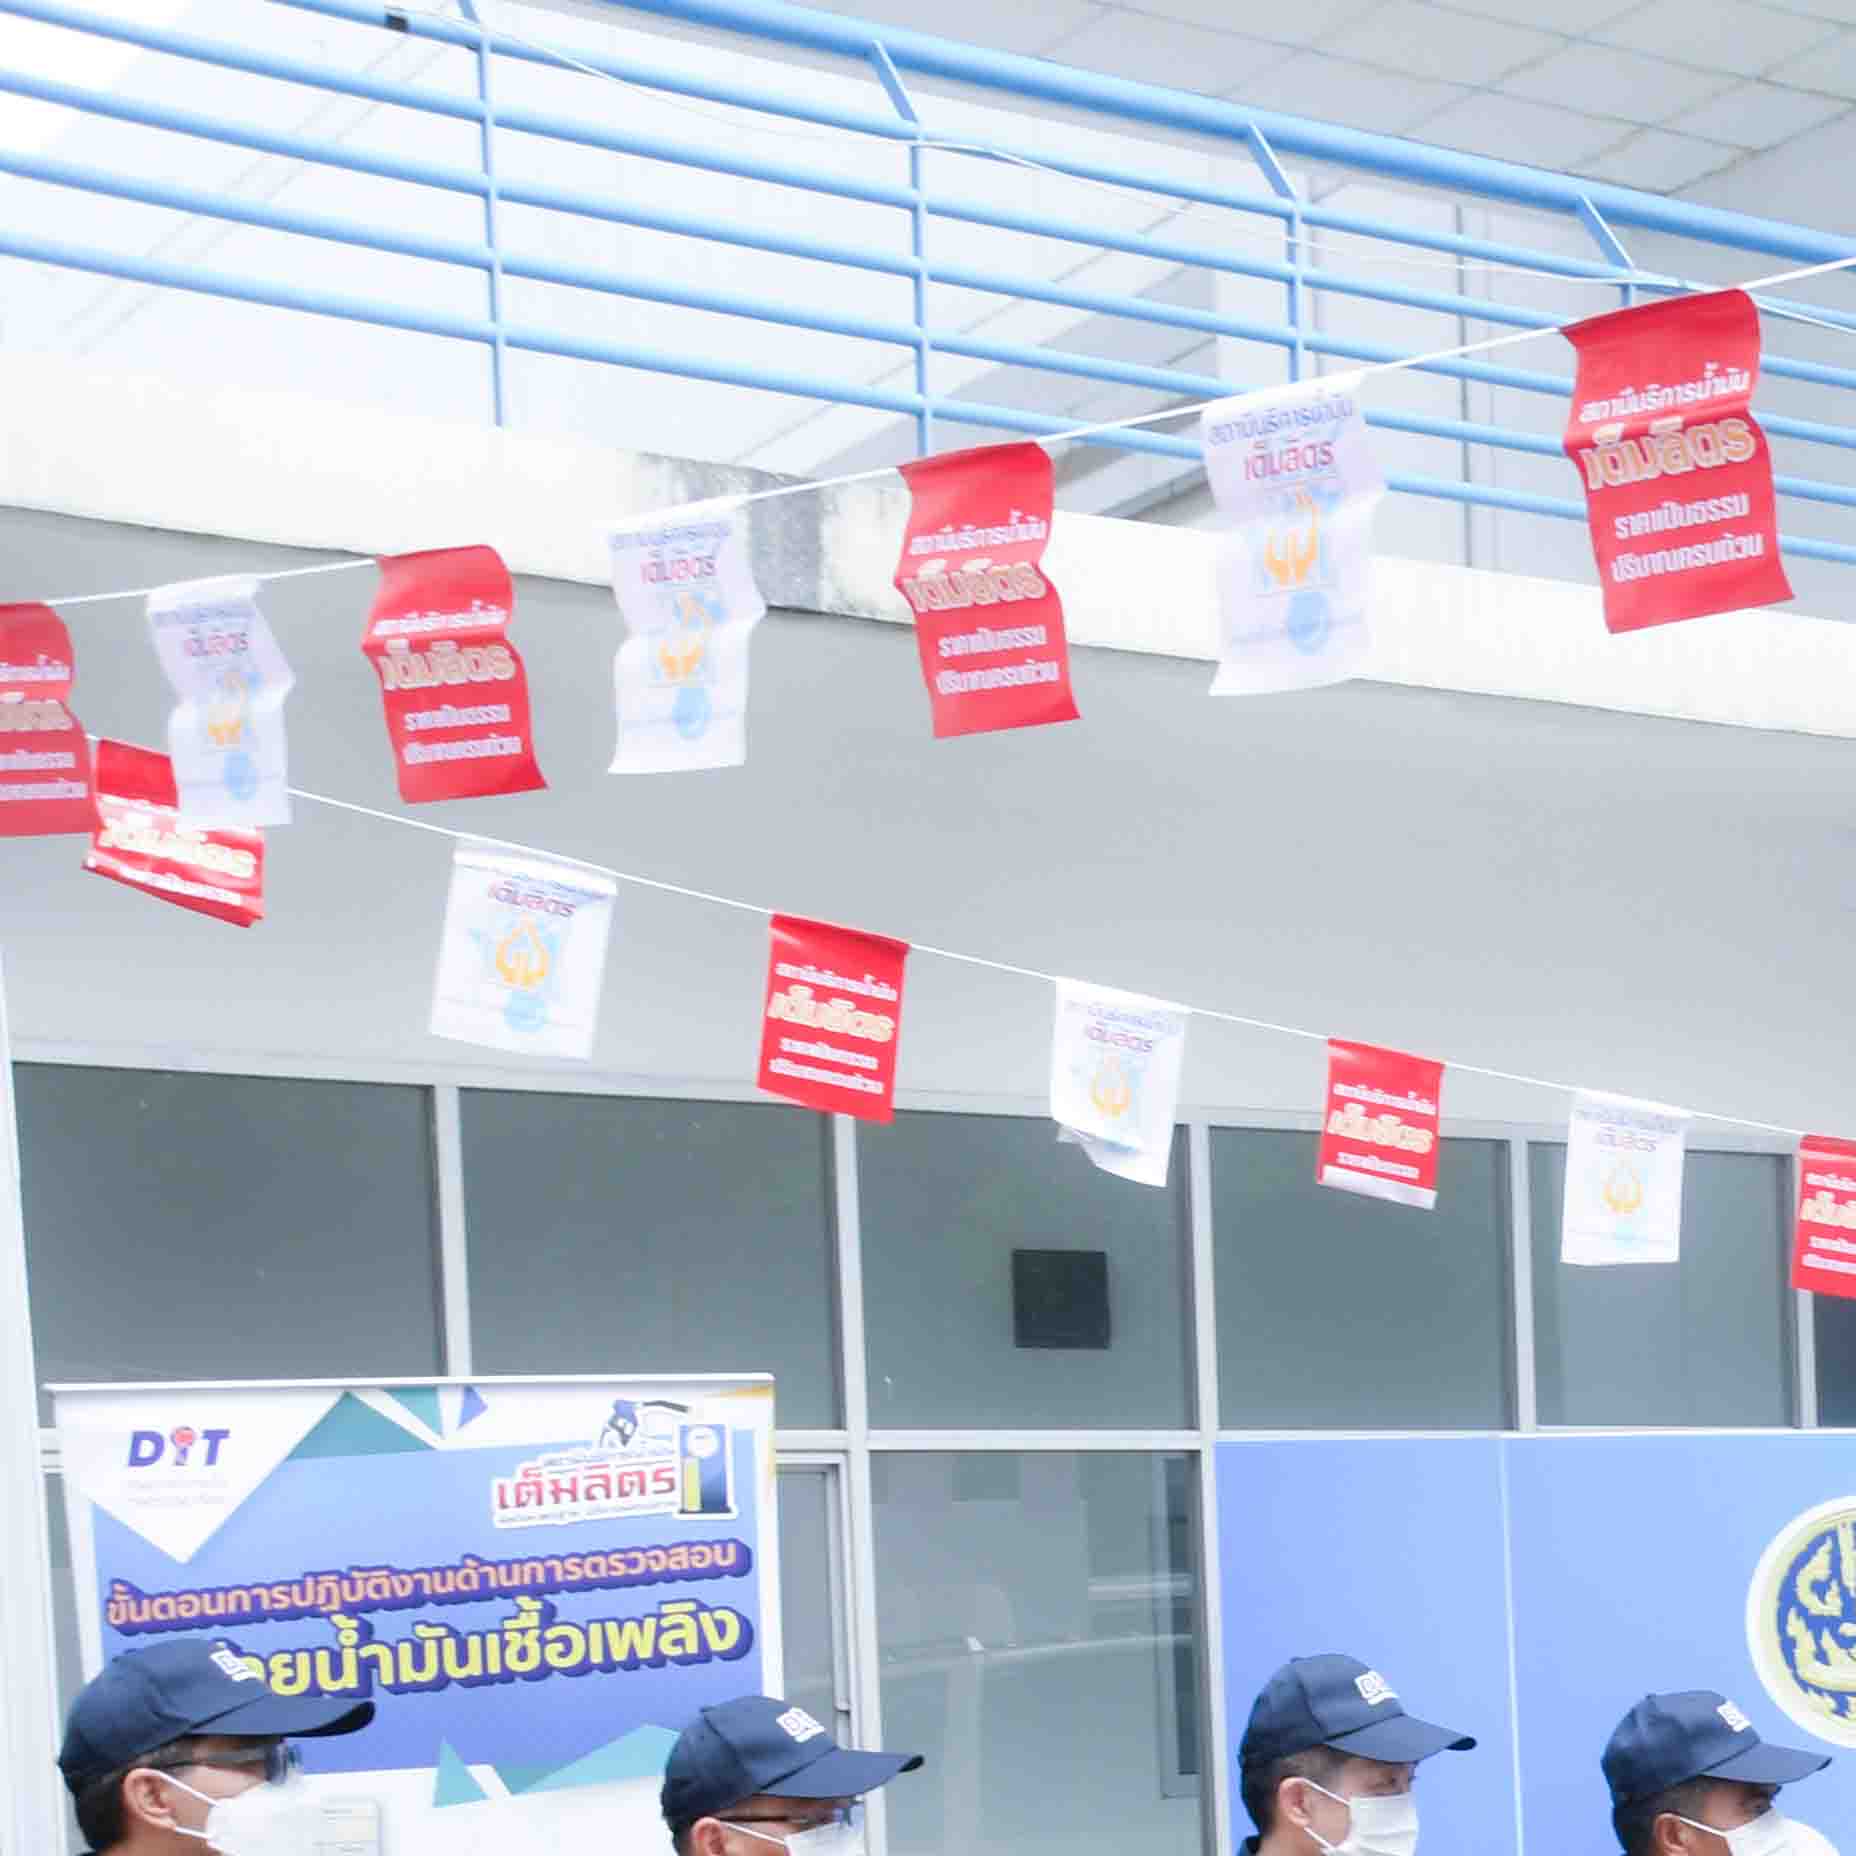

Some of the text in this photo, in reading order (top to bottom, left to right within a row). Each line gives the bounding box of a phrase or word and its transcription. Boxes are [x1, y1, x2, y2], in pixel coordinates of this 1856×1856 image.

[1578, 362, 1752, 426] สถานีบริการน้ำมัน
[1242, 435, 1334, 482] เต็มลิตร
[1578, 414, 1758, 492] เต็มลิตร
[1613, 494, 1750, 540] ราคาเป็นธรรม
[902, 556, 1048, 612] เต็มลิตร
[1612, 535, 1764, 583] ปริมาณครบถ้วน
[127, 1426, 231, 1467] DIT
[498, 1464, 677, 1510] เต็มลิตร
[107, 1539, 740, 1628] ขั้นตอนการปฏิบัติงานด้านการตรวจสอบ
[218, 1596, 742, 1697] ายน้ำมันเชื้อเพลิง
